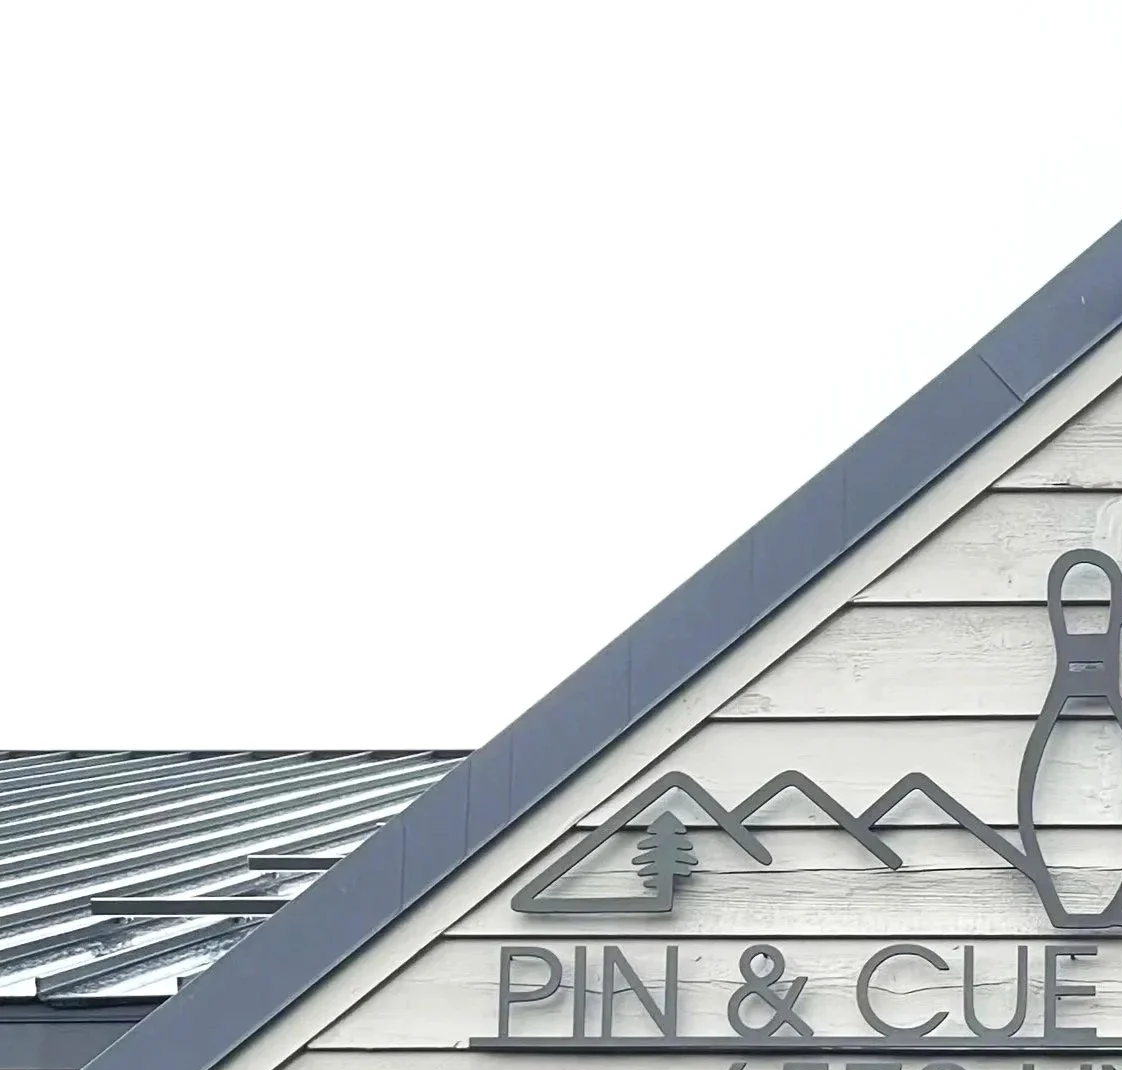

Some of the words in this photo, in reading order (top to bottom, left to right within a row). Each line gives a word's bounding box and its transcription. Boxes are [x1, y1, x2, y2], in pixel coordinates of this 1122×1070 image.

[499, 945, 678, 1038] PIN
[727, 944, 814, 1038] &
[856, 944, 1098, 1038] CUE
